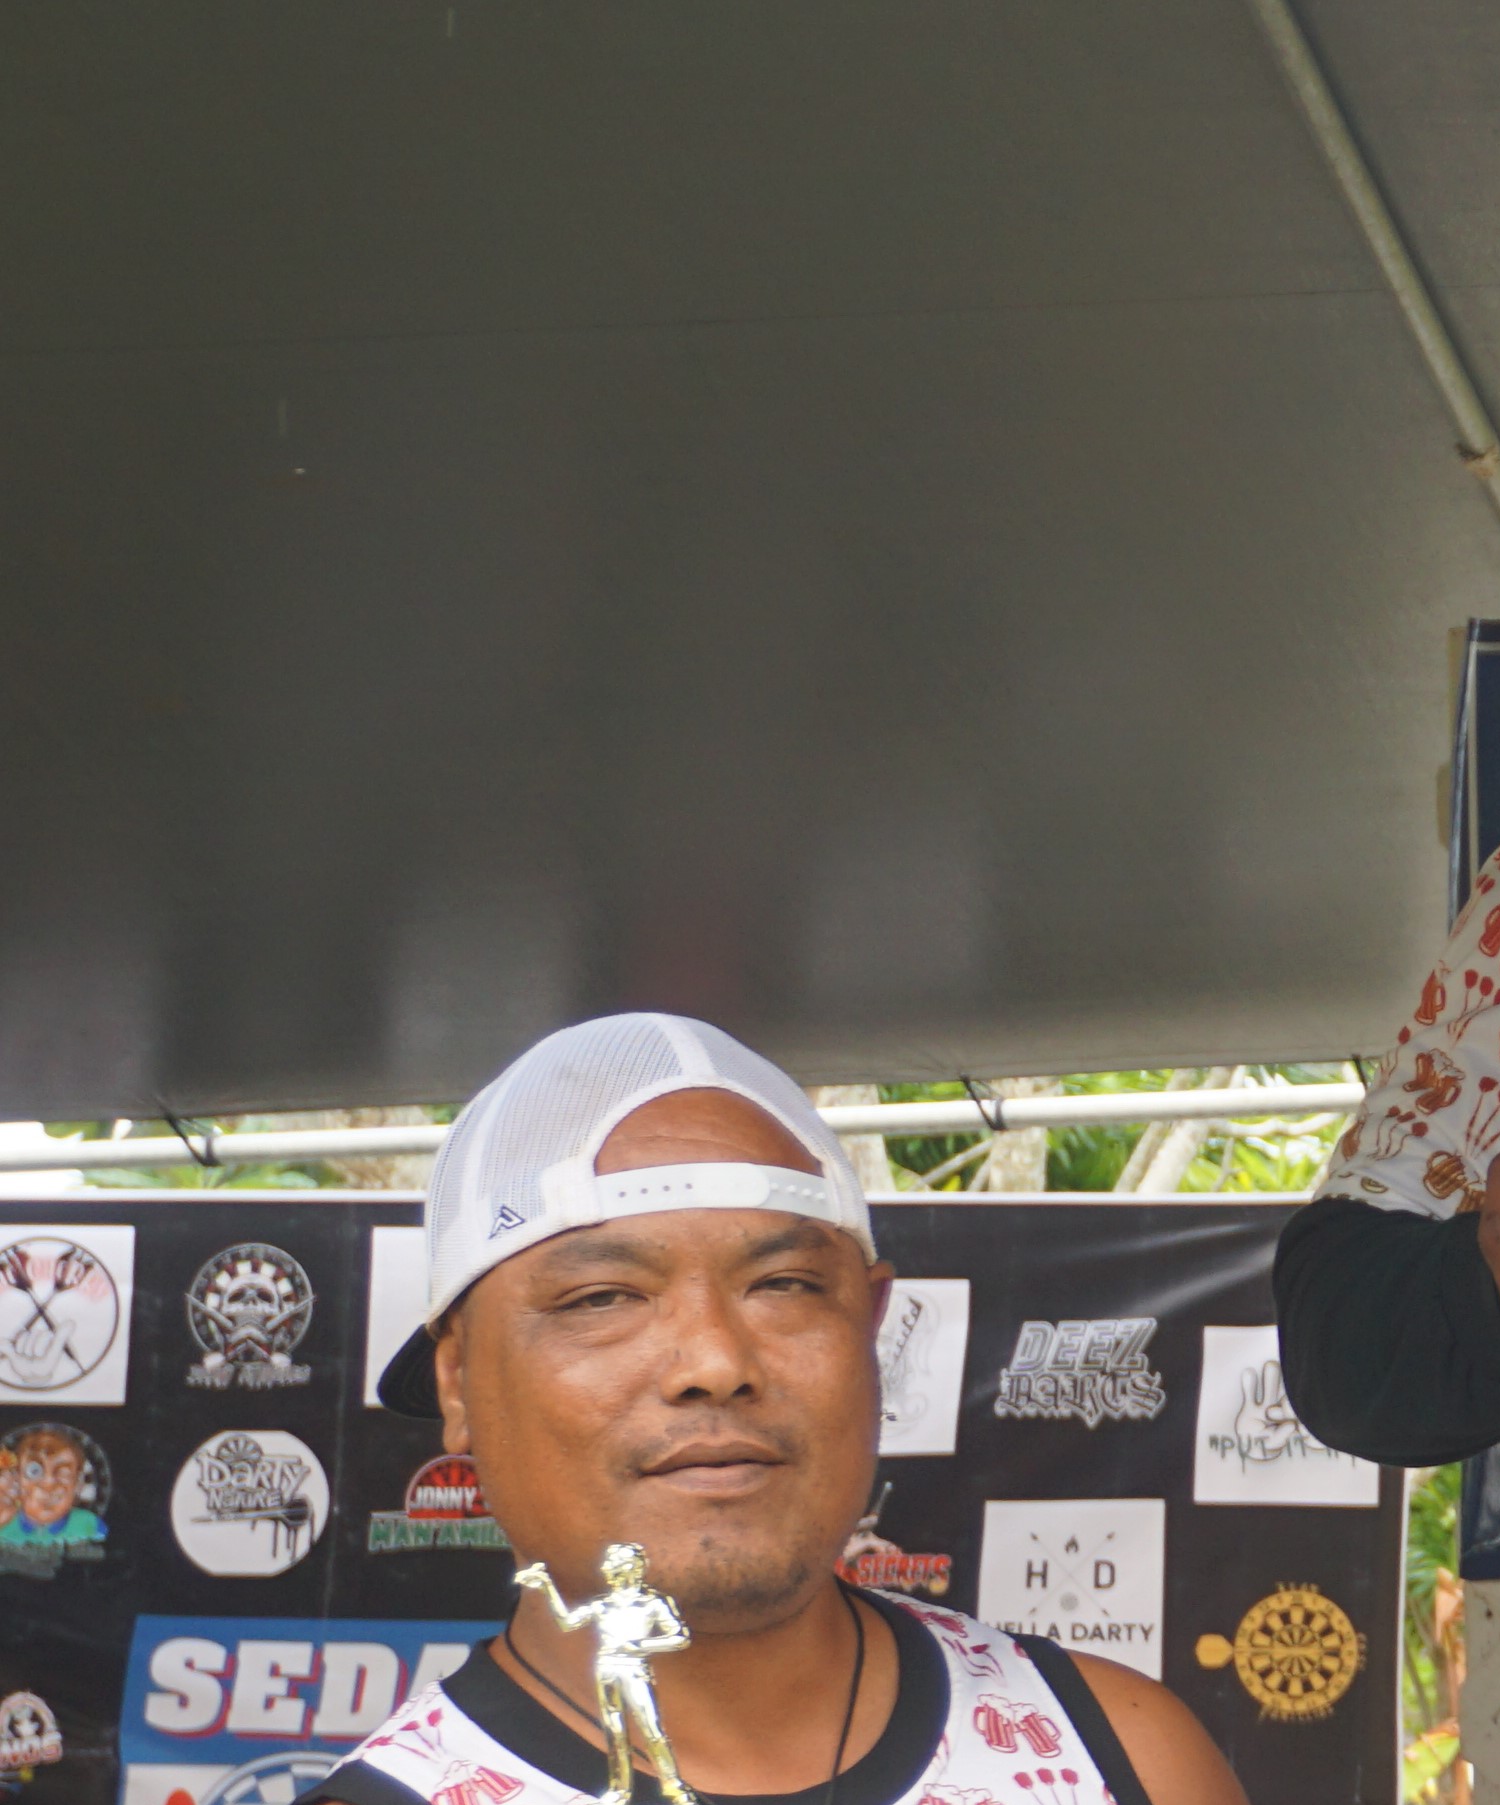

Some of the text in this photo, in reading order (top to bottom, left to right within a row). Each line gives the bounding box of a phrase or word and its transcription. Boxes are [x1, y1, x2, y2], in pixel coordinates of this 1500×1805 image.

[1010, 1317, 1158, 1371] DEEZ
[411, 1486, 478, 1510] JONNY
[856, 1553, 951, 1588] SECRETS
[1026, 1559, 1116, 1590] H D
[1071, 1623, 1155, 1643] DARTY
